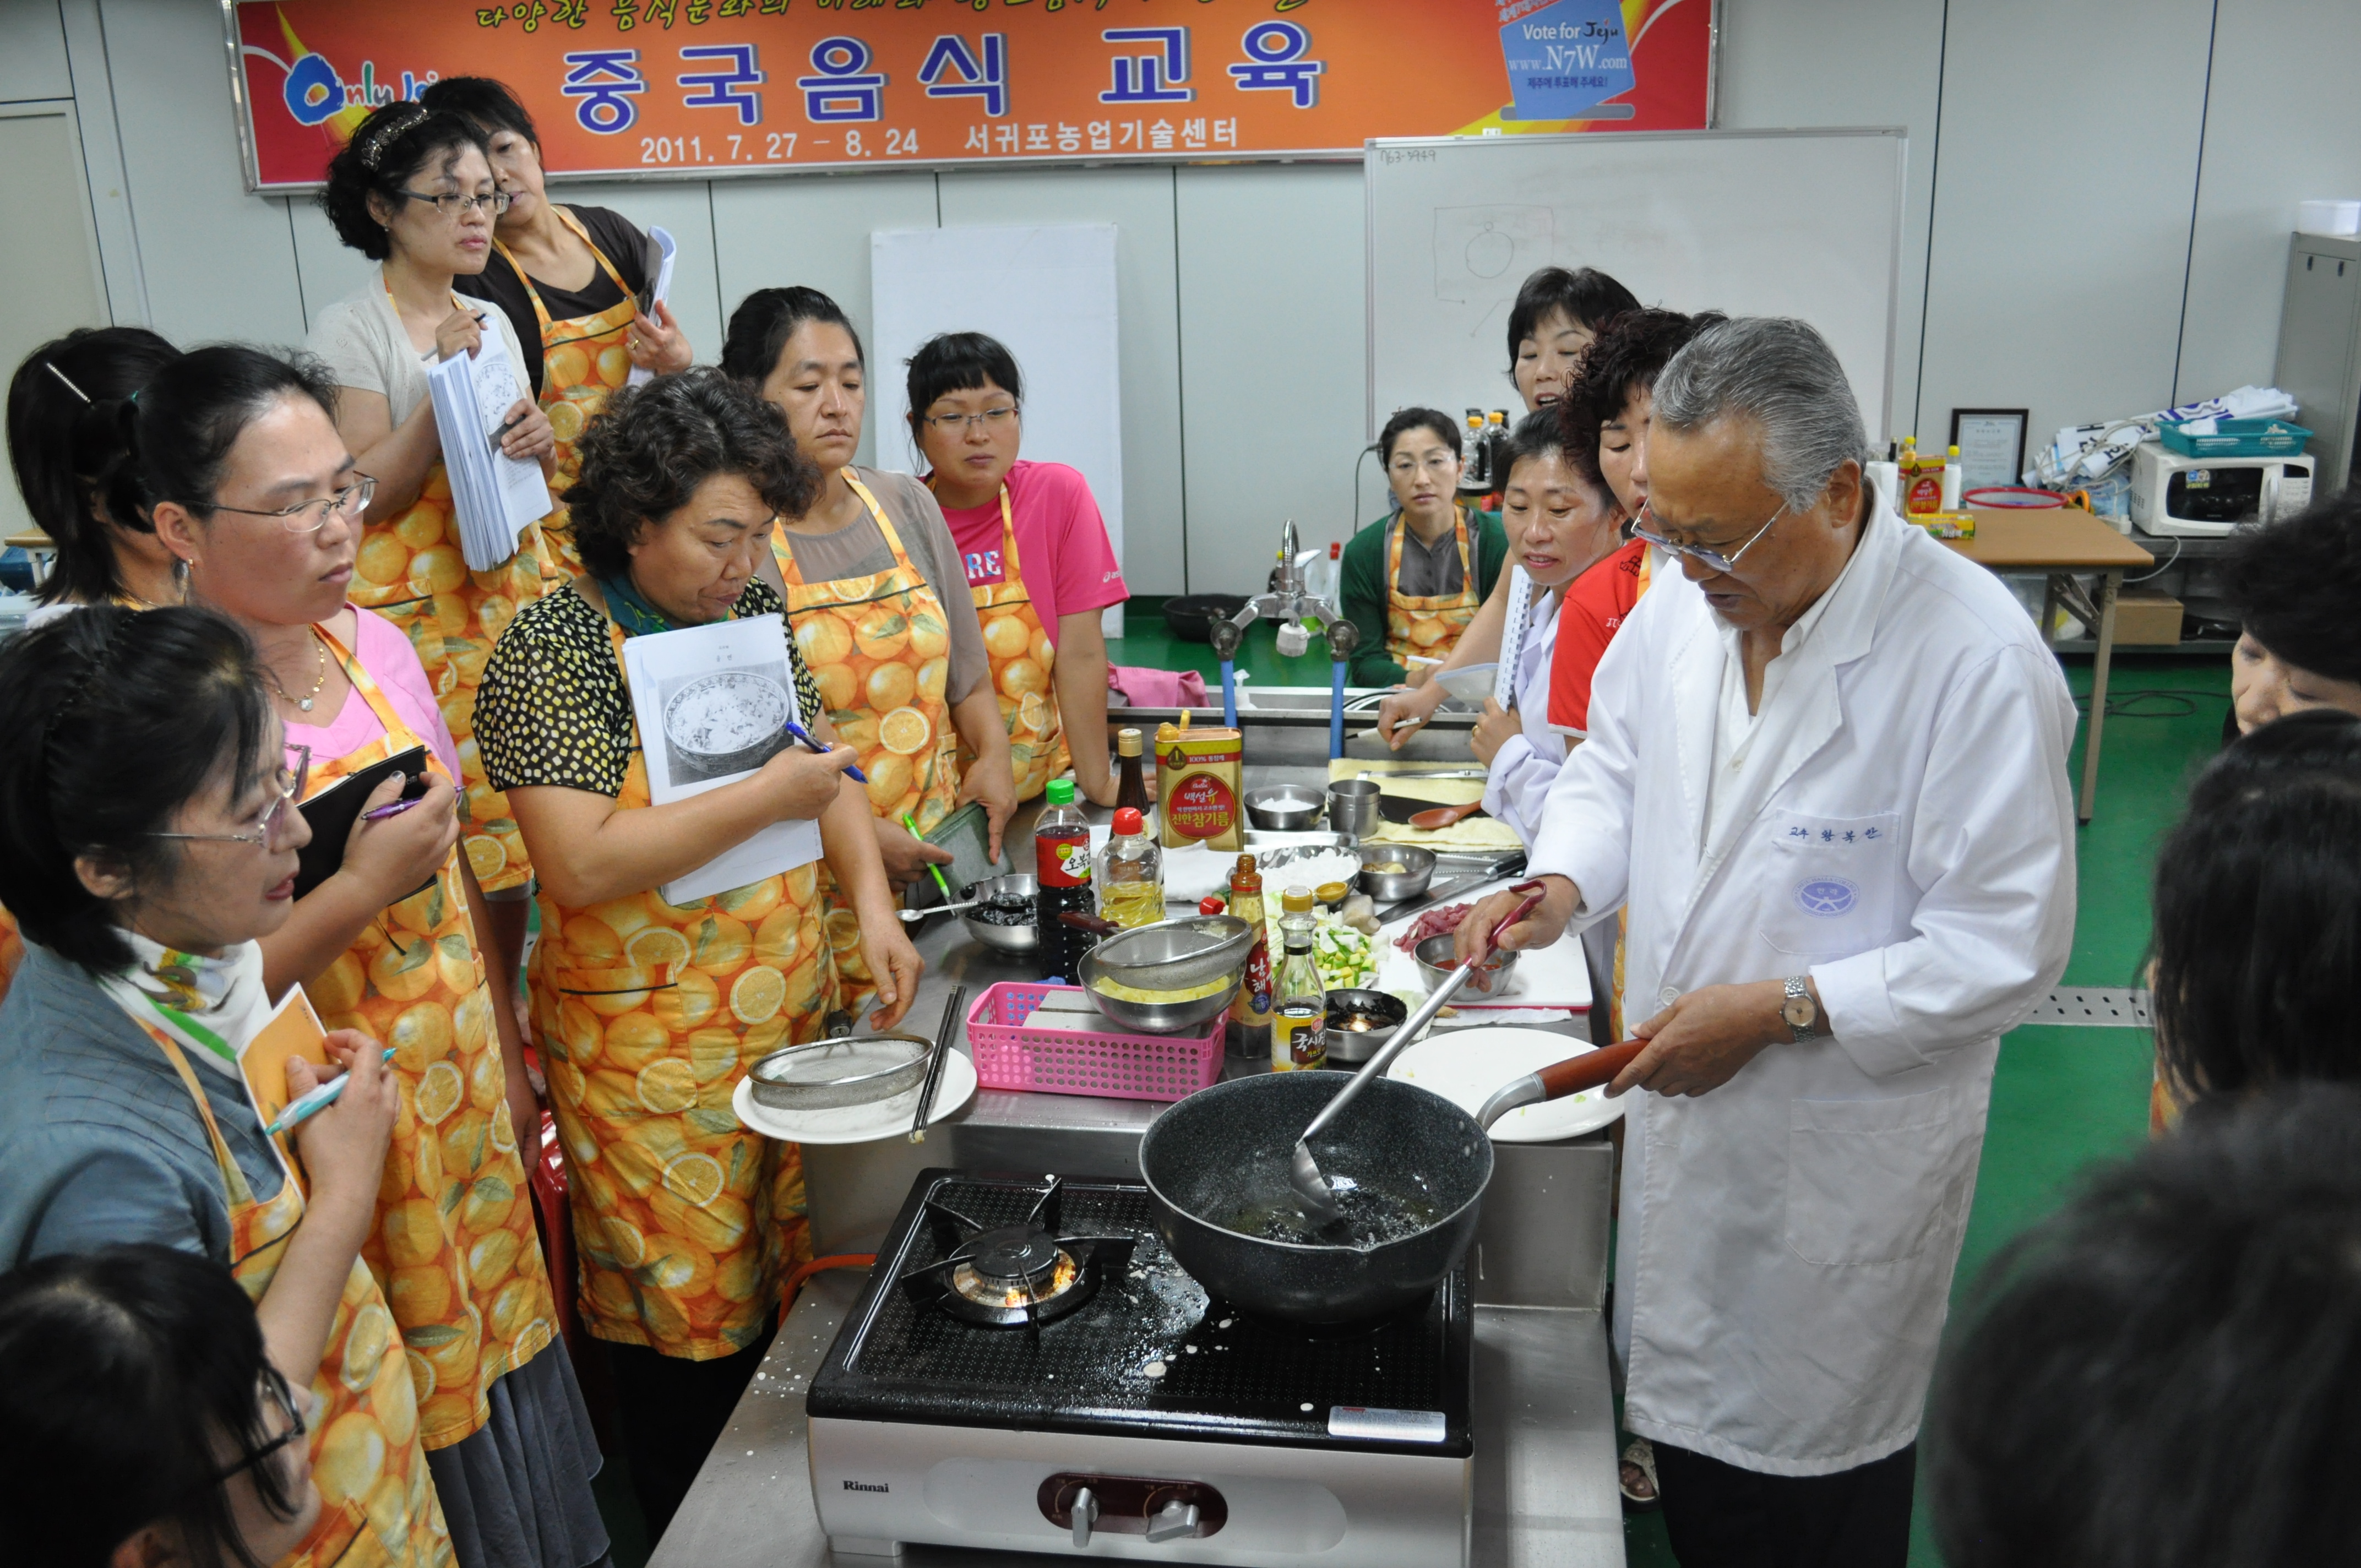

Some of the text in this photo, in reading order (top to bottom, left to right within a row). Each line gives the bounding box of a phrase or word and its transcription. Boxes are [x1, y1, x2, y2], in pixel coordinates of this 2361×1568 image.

[1522, 18, 1619, 45] Vote for Jeju
[1098, 20, 1328, 109] 교육
[1508, 44, 1628, 75] www.N7W.com
[640, 136, 715, 163] 2011.
[766, 133, 798, 158] 27
[885, 128, 919, 155] 24
[842, 1480, 889, 1493] Rinnai
